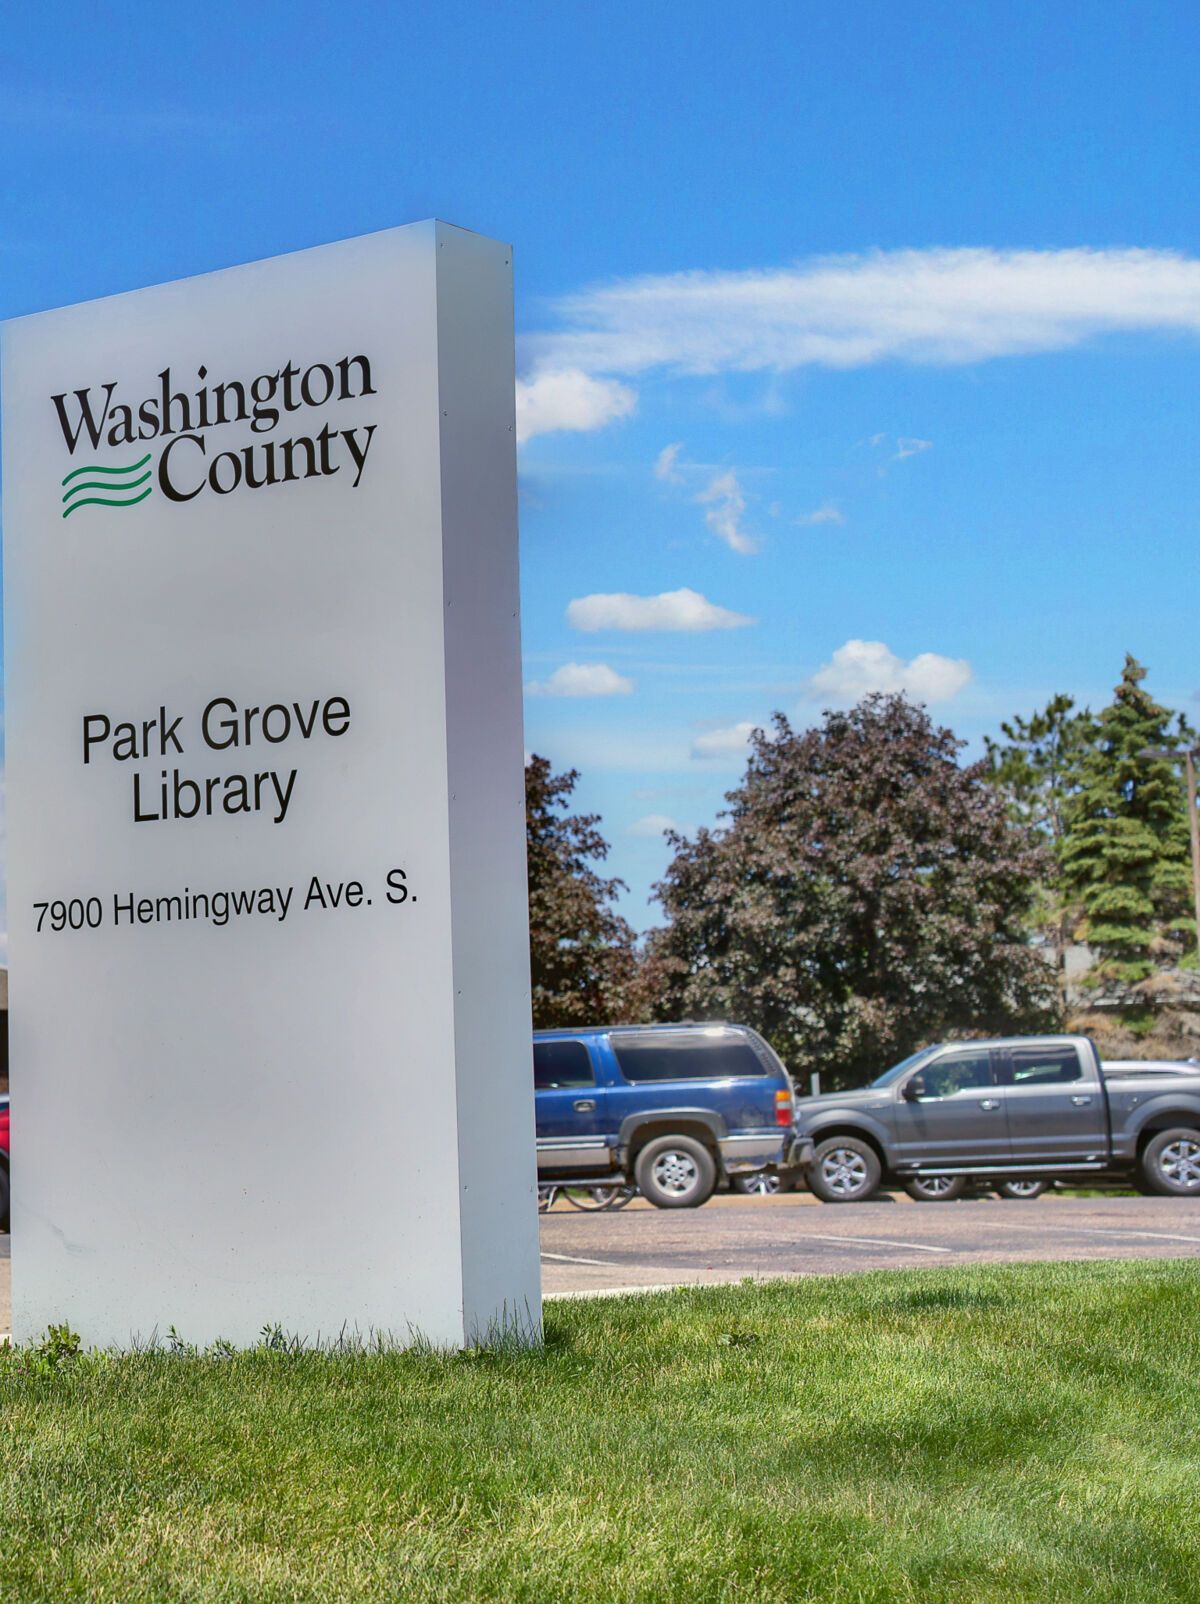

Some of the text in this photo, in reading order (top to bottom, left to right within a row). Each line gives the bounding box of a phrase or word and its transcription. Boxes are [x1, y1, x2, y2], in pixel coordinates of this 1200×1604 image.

[50, 354, 378, 455] Washington
[157, 422, 378, 503] County
[83, 696, 351, 765] Park Grove
[133, 768, 298, 824] Library
[33, 868, 418, 933] 7900 Hemingway Ave. S.
